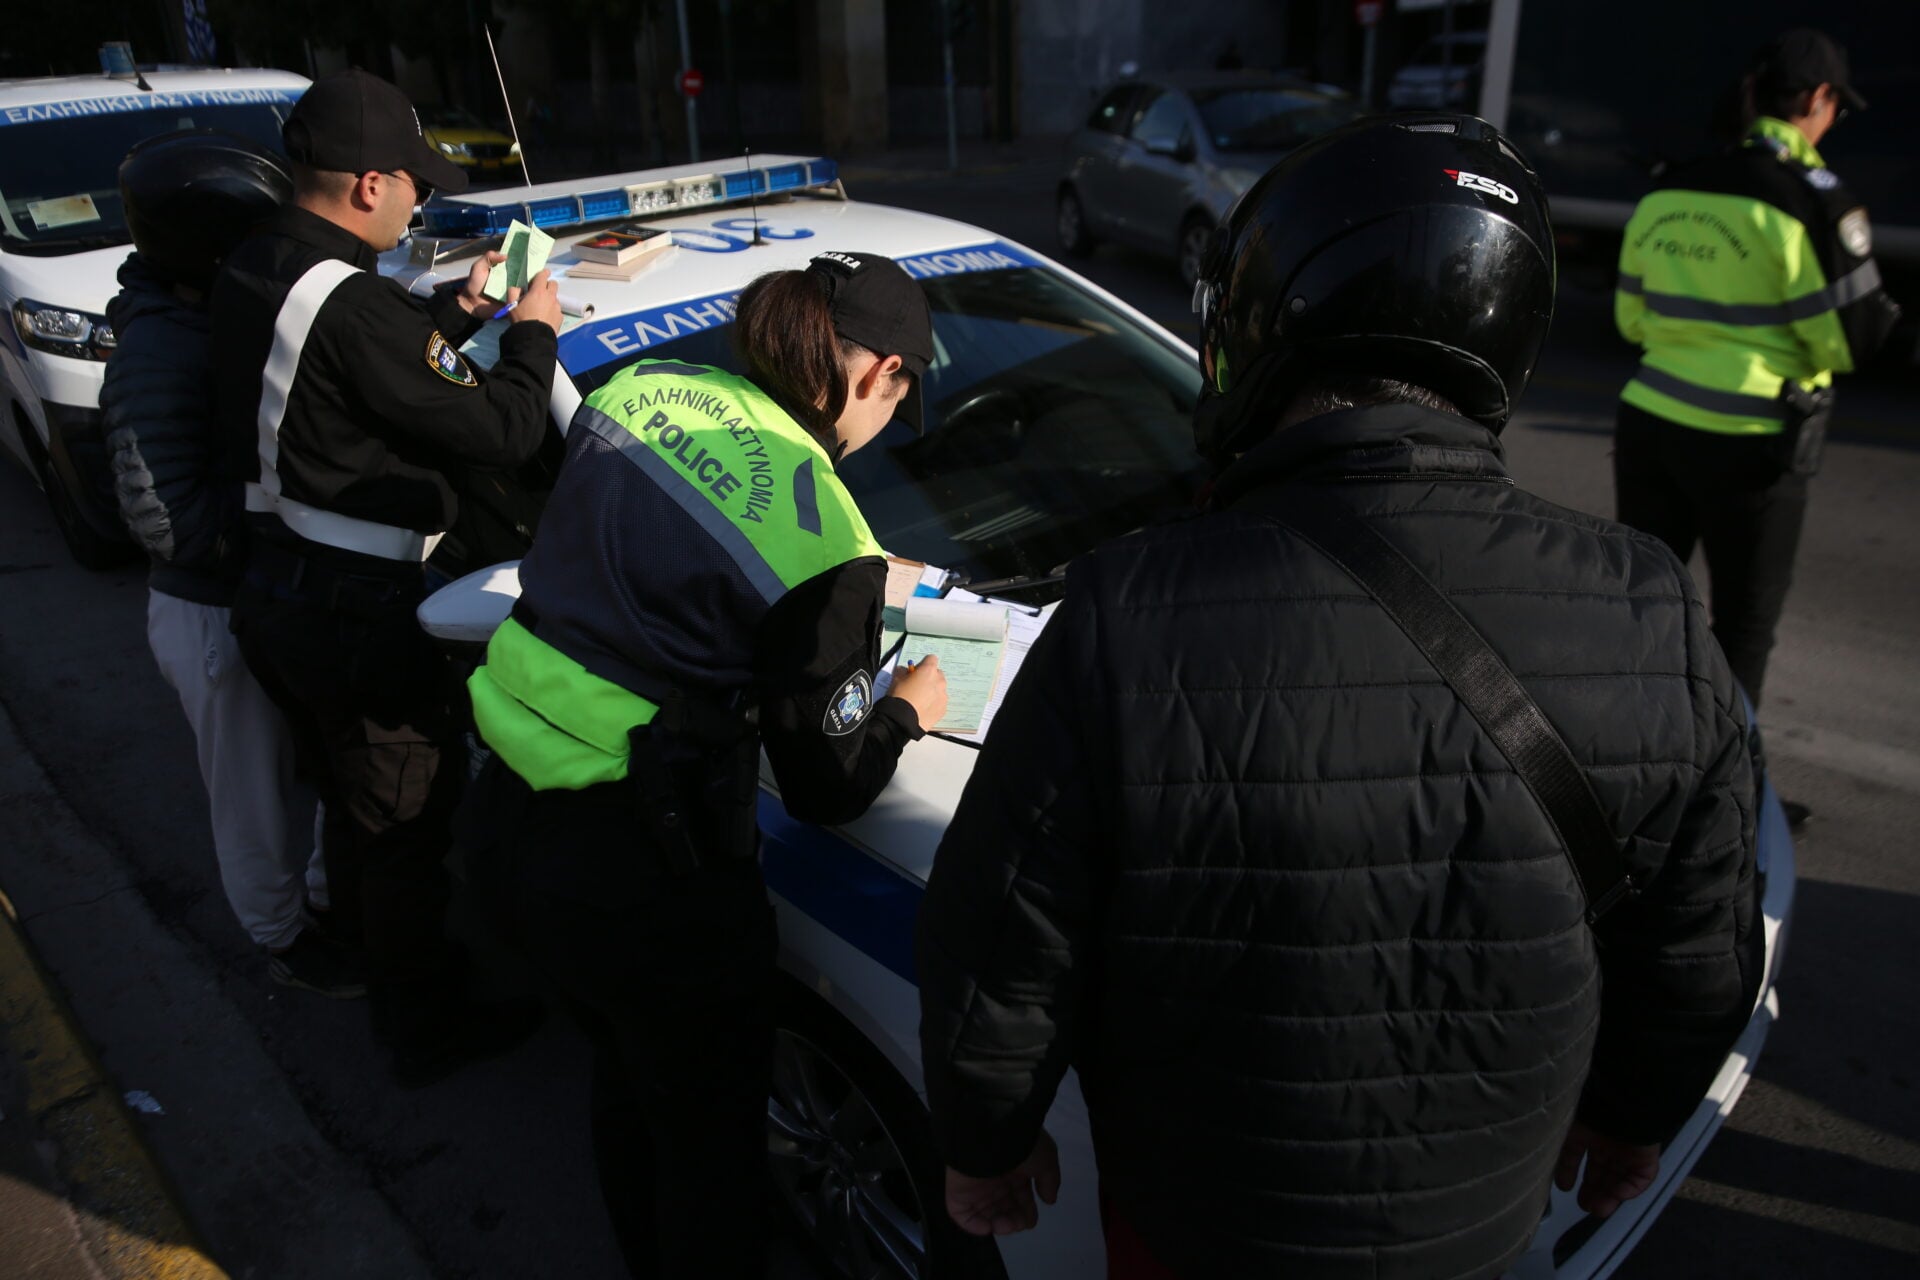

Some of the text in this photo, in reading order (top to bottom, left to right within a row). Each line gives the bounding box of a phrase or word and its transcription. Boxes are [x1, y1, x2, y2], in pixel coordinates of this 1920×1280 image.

[5, 89, 290, 123] ΕΛΛΗΝΙΚΗ ΑΣΤΥΝΟΜΙΑ
[597, 250, 1022, 356] ΕΛΛΗΝ ΥΝΟΜΙΑ
[623, 388, 774, 523] ΕΛΛΗΝΙΚΗ ΑΣΤΥΝΟΜΙΑ
[643, 410, 743, 502] POLICE
